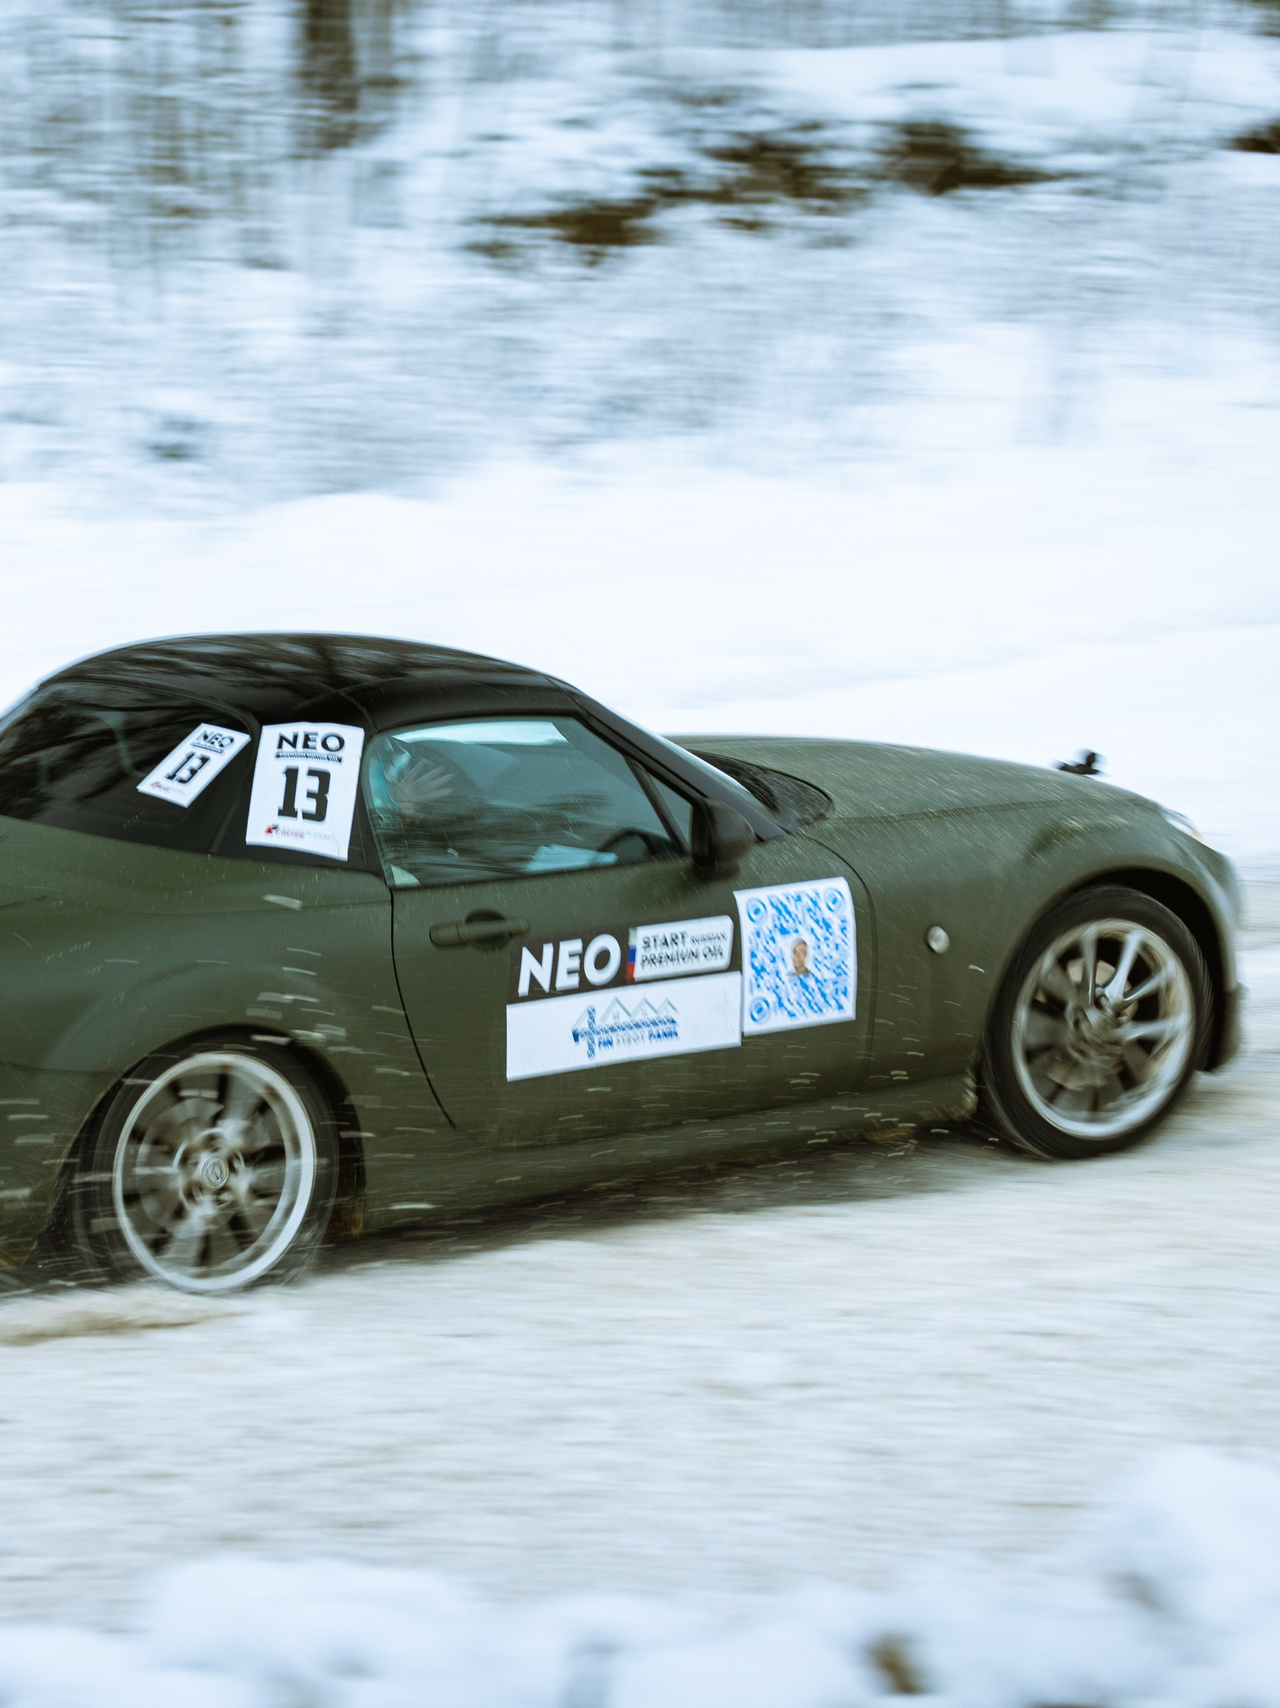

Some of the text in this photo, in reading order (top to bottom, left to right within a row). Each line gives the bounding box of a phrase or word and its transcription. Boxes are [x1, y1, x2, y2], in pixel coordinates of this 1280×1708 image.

[277, 731, 345, 752] NEO
[164, 751, 211, 784] 13
[277, 765, 331, 822] 13
[642, 931, 687, 951] START
[518, 933, 621, 997] NEO
